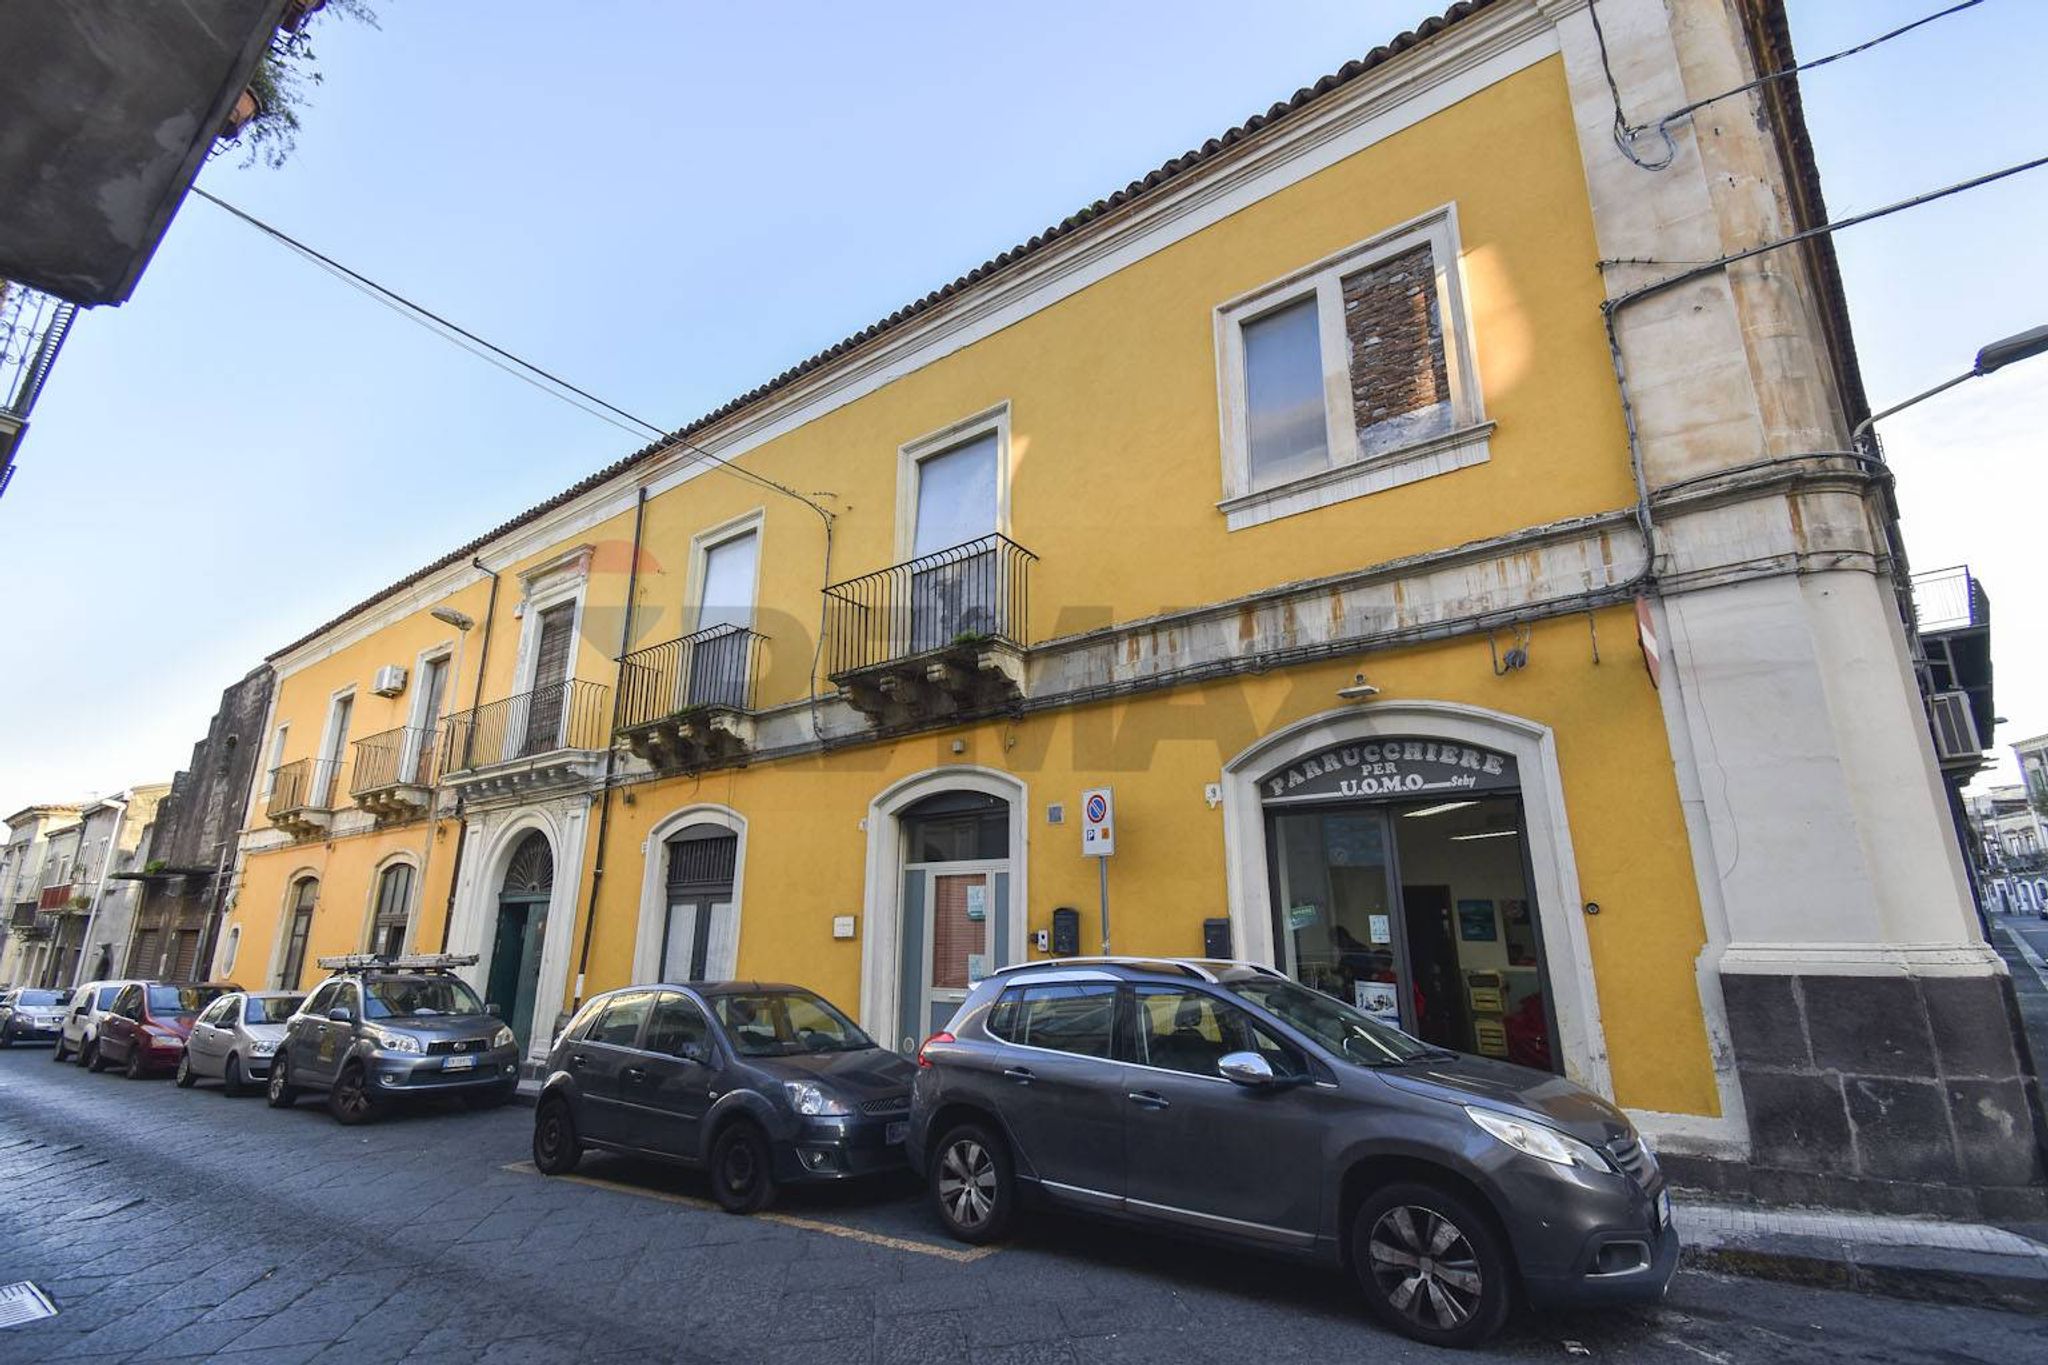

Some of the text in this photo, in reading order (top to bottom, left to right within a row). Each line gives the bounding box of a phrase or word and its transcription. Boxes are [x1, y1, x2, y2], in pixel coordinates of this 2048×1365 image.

[1269, 741, 1504, 796] PARRUCCHIERE
[1361, 762, 1398, 776] PER
[1450, 774, 1476, 788] Seby
